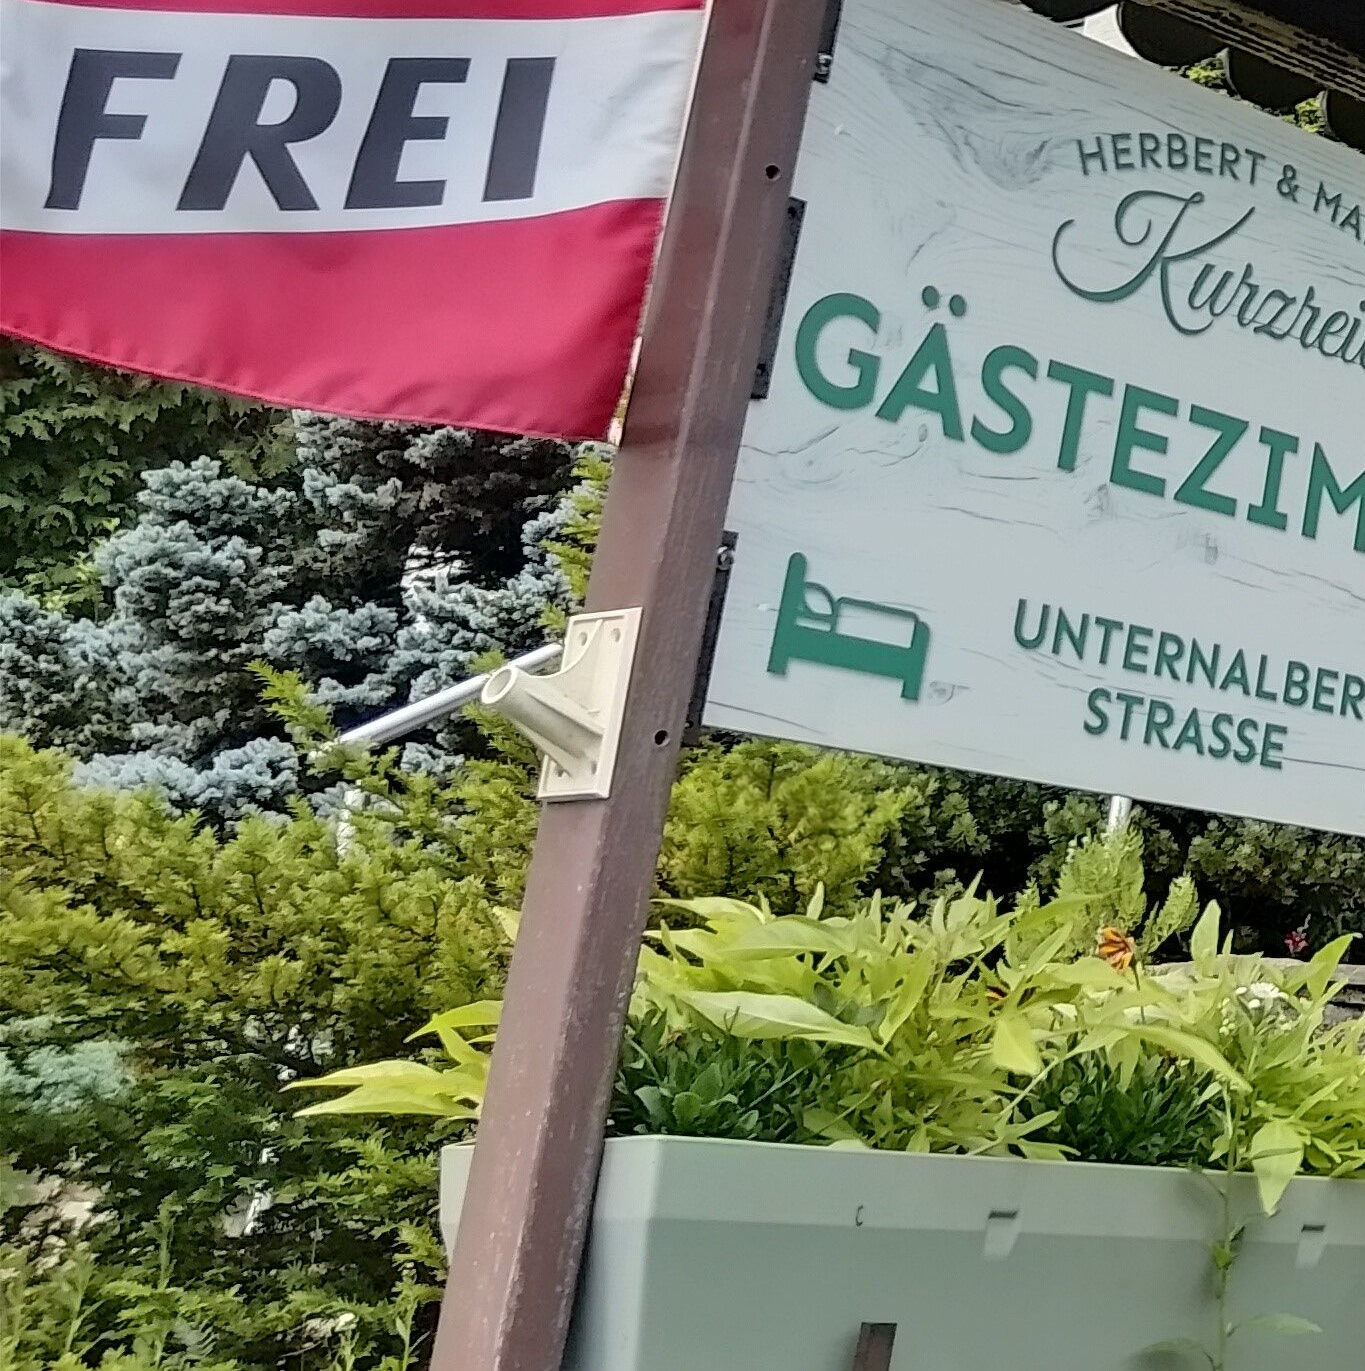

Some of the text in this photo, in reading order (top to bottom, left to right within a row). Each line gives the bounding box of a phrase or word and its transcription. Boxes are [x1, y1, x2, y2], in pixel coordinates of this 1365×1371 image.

[44, 48, 557, 212] FREI
[1077, 132, 1267, 185] HERBERT
[1276, 163, 1299, 203] &
[1082, 687, 1288, 770] STRASSE
